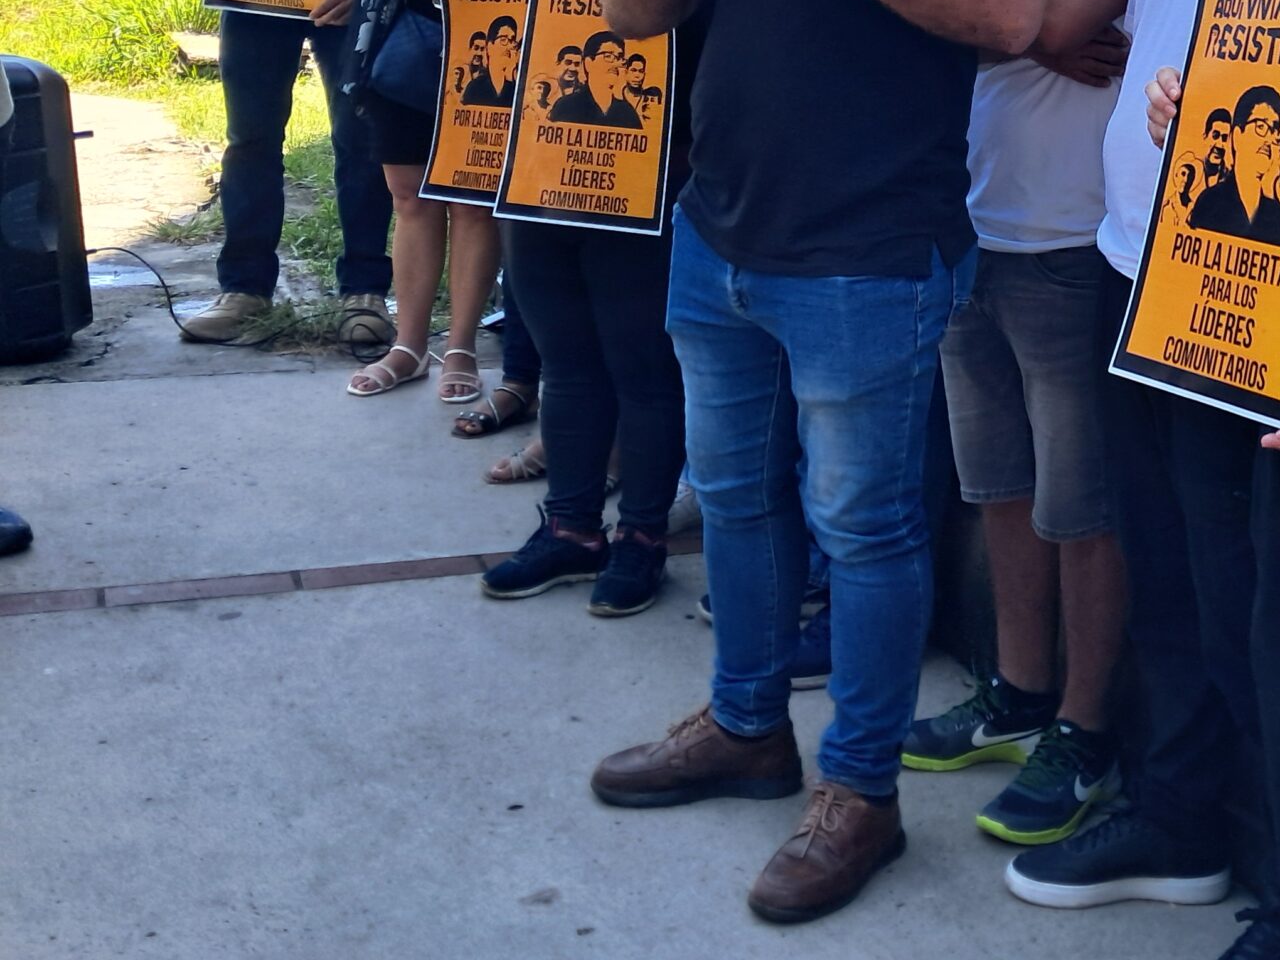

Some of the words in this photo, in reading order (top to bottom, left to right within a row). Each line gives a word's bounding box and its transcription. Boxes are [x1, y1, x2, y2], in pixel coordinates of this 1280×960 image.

[453, 109, 471, 127] POR
[472, 111, 482, 129] LA
[484, 112, 510, 130] LIBER
[471, 130, 488, 144] PARA
[490, 133, 504, 147] LOS
[536, 125, 563, 144] POR
[567, 128, 583, 147] LA
[585, 129, 648, 153] LIBERTAD
[466, 146, 503, 168] LÍDERES
[566, 149, 593, 166] PARA
[596, 152, 616, 168] LOS
[560, 164, 616, 190] LÍDERES
[540, 189, 629, 214] COMUNITARIOS
[1171, 232, 1202, 266] POR
[1203, 240, 1222, 271] LA
[1200, 274, 1232, 303] PARA
[1234, 283, 1258, 310] LOS
[1189, 300, 1255, 349] LÍDERES
[1163, 336, 1268, 390] COMUNITARIOS
